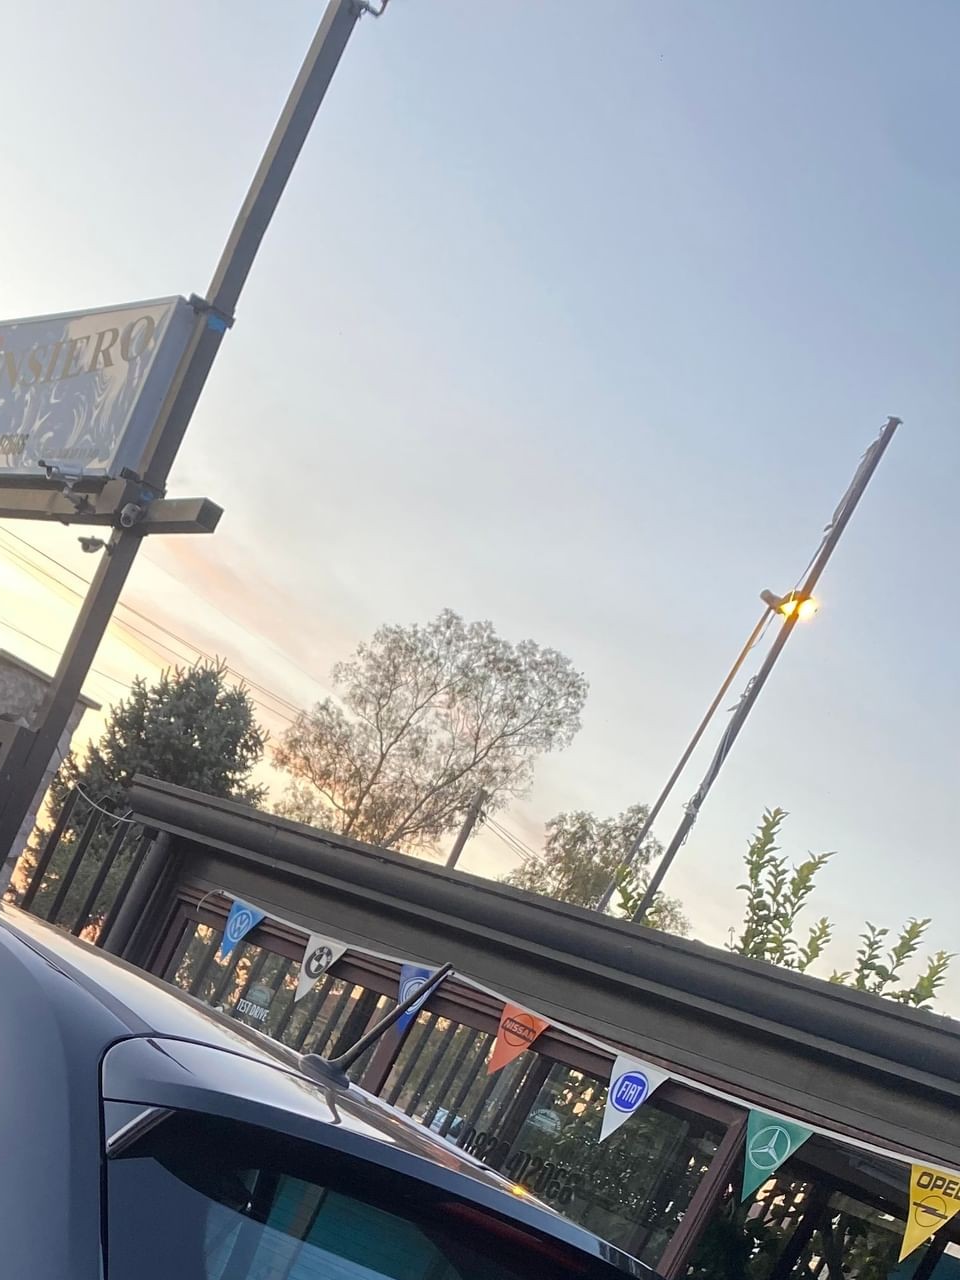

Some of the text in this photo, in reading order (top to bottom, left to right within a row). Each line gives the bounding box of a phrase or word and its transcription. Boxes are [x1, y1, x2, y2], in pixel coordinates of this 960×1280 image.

[236, 998, 270, 1021] TEST DRIVE
[503, 1019, 536, 1040] NISSAN
[617, 1080, 643, 1104] FIAT
